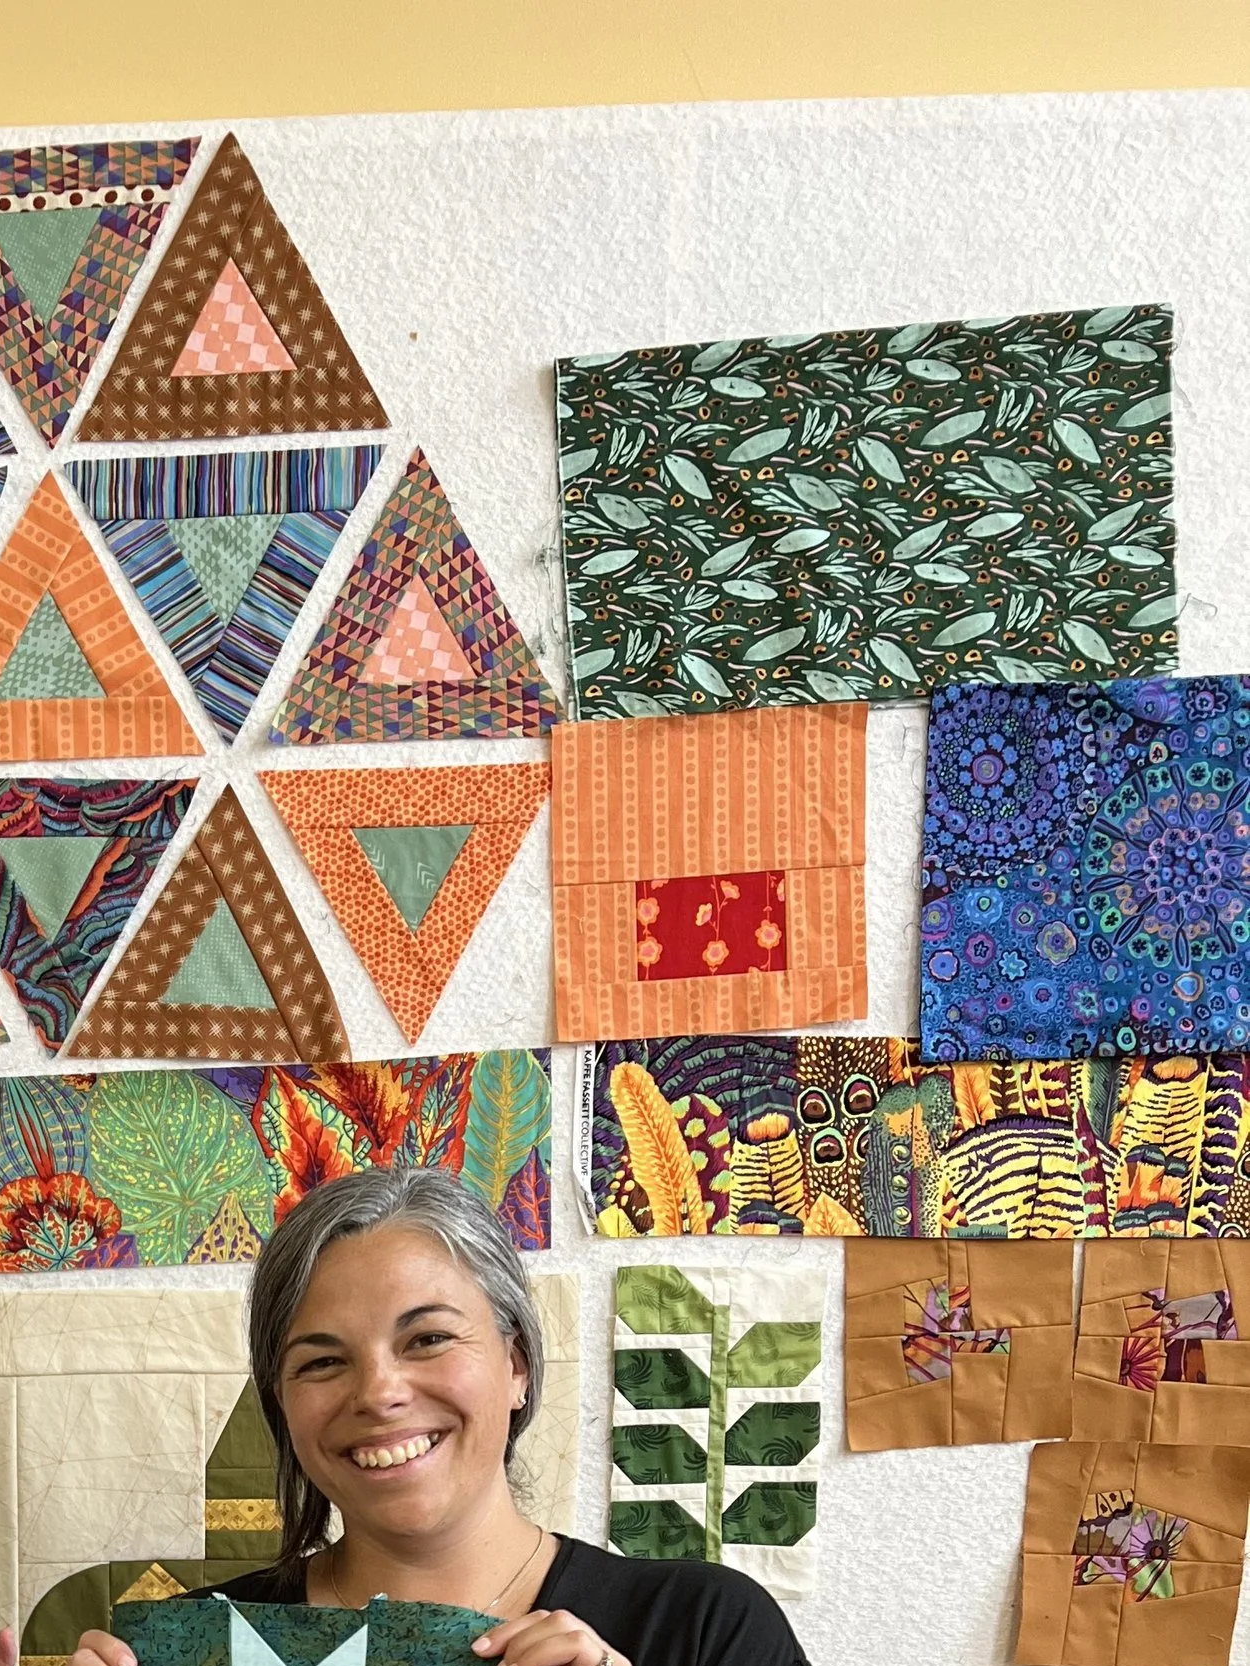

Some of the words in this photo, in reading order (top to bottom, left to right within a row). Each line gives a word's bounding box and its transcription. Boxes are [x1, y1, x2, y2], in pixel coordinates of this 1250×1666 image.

[584, 1050, 592, 1077] KAFFE
[581, 1081, 591, 1119] FASSETT
[580, 1121, 590, 1176] COLLECTIVE
